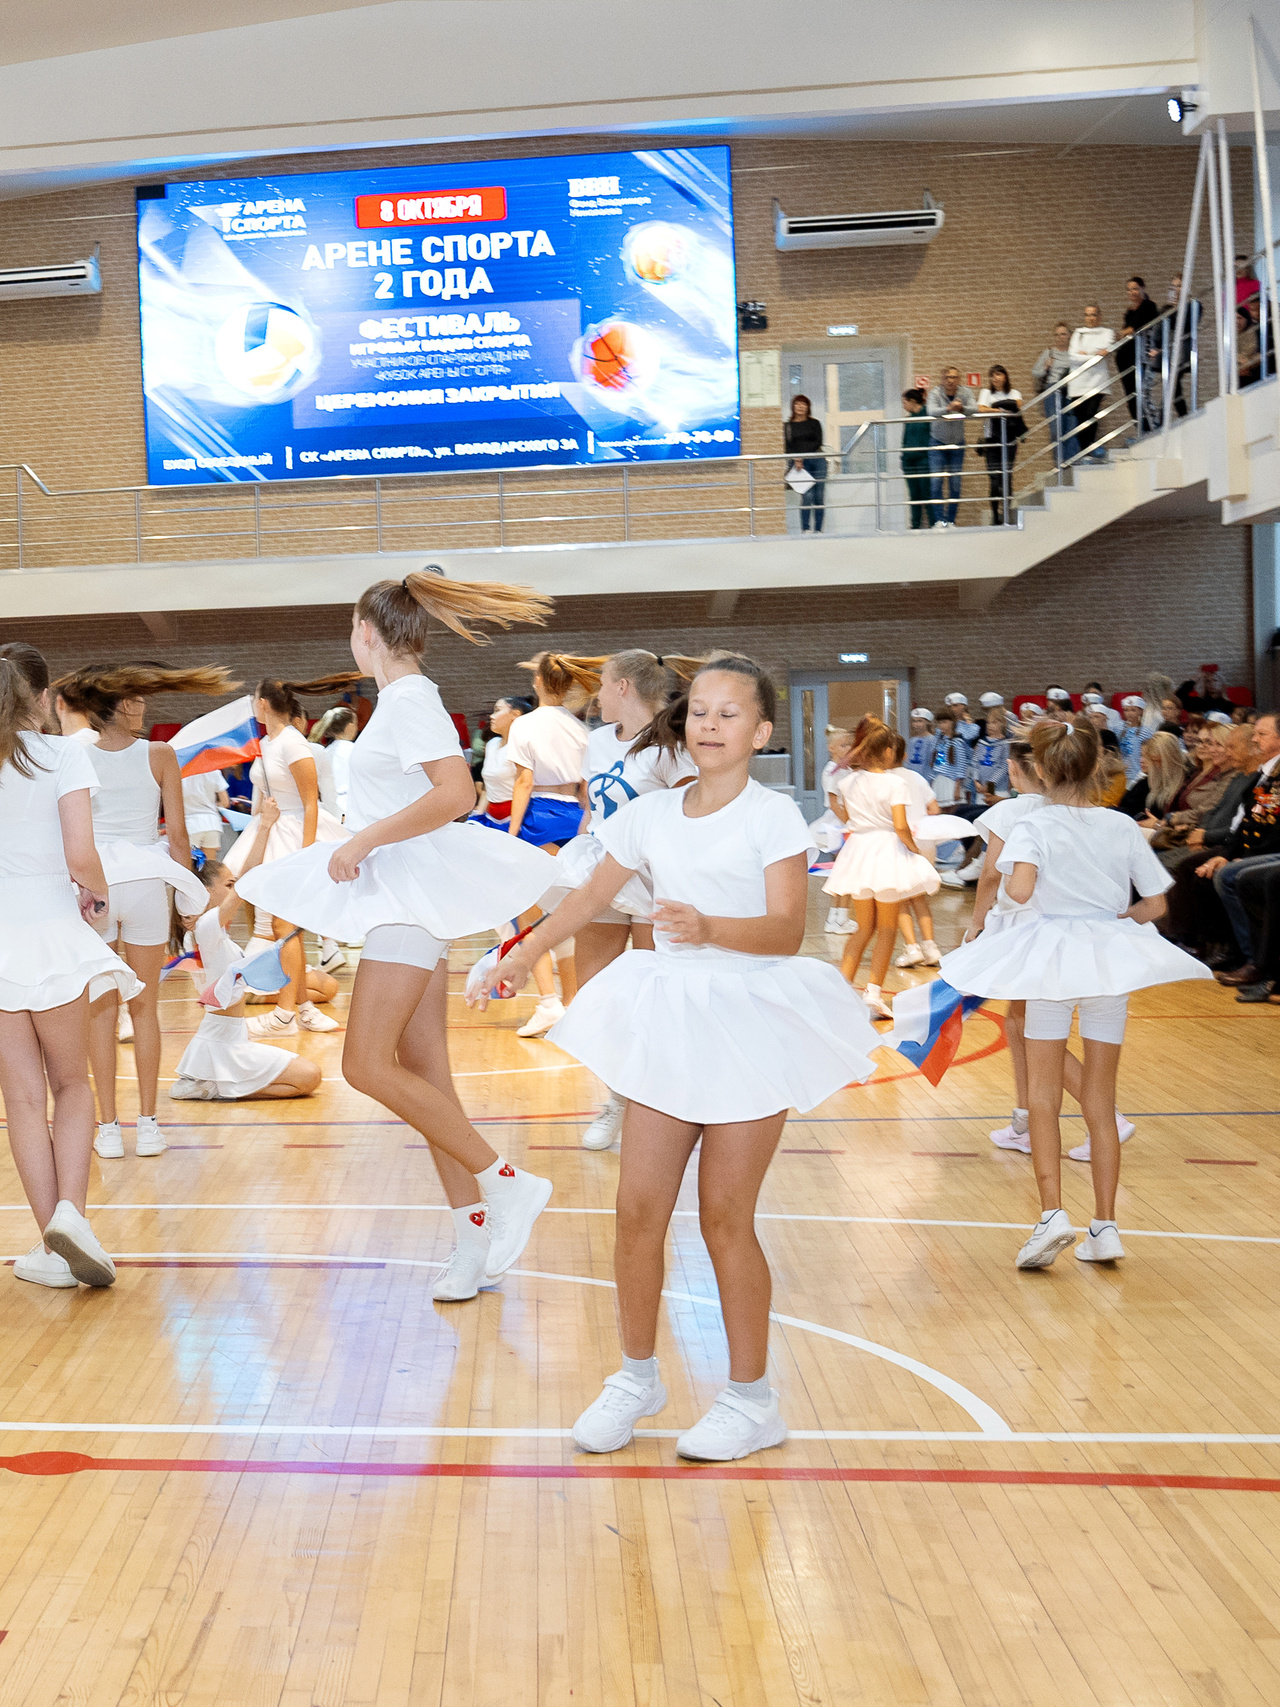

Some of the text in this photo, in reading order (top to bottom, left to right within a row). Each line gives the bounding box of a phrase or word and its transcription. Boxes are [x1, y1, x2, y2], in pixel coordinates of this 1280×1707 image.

[242, 199, 307, 215] АРЕНА
[380, 194, 482, 222] 8 ОКТЯБРЯ
[231, 215, 307, 233] СПОРТА
[301, 229, 556, 270] АРЕНЕ СПОРТА
[374, 267, 494, 301] 2 ГОДА
[359, 311, 520, 340] ФЕСТИВАЛЬ
[315, 381, 561, 412] ЦЕРЕМОНИЯ ЗАКРЫТИЯ
[299, 451, 320, 463] СК
